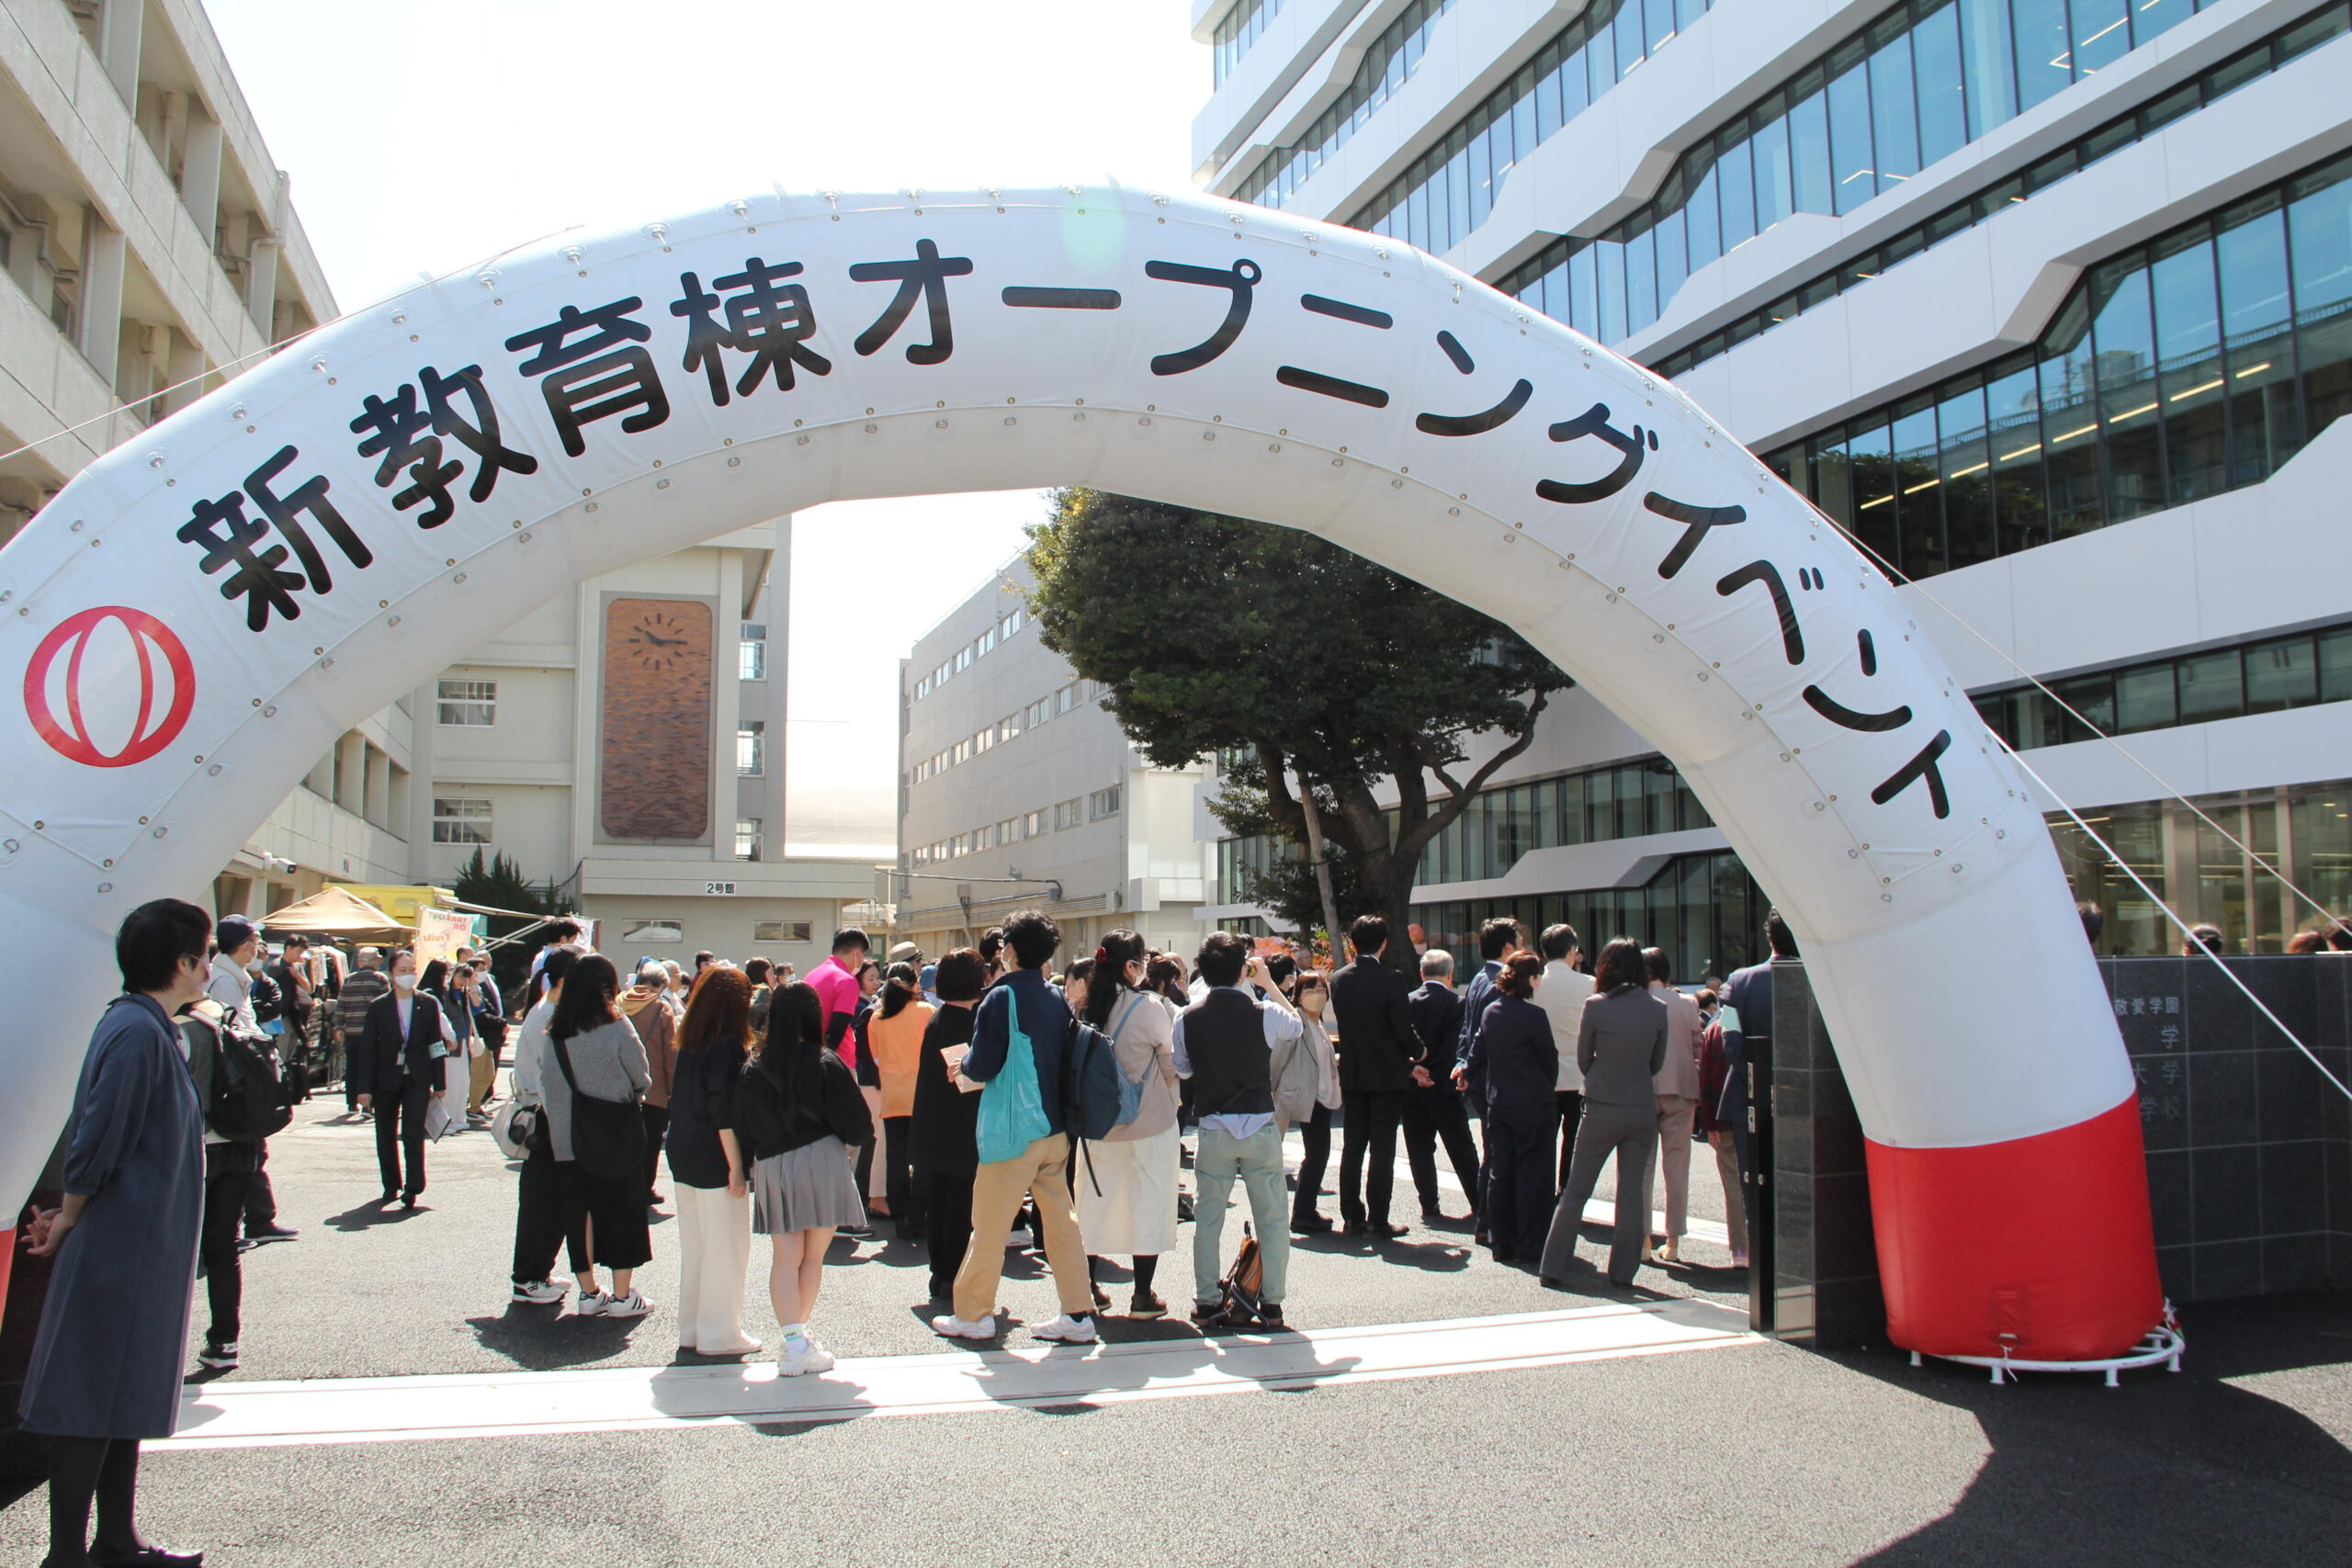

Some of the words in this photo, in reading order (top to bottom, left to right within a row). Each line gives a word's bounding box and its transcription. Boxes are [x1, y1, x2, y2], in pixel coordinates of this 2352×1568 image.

[176, 238, 1951, 819] 新教育棟オープニングイベント
[707, 883, 735, 894] 2号館
